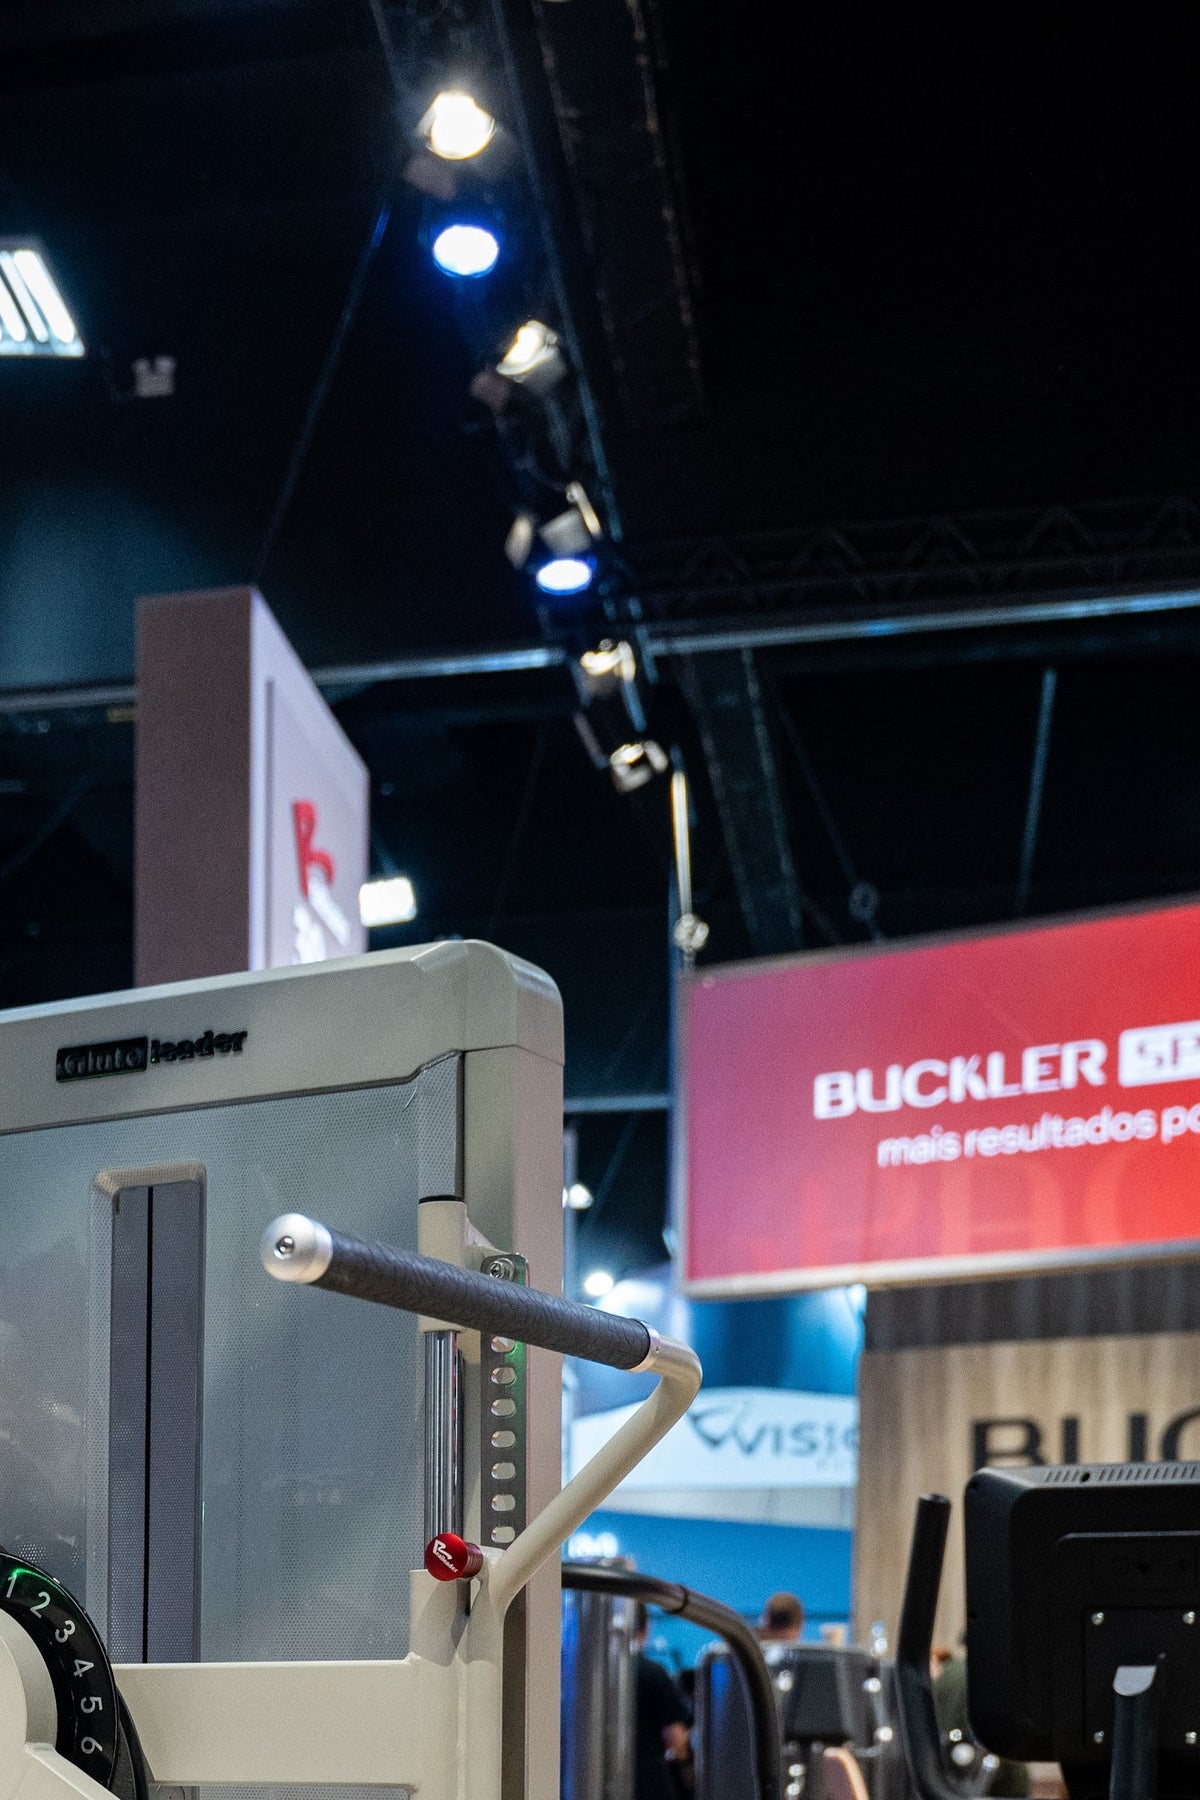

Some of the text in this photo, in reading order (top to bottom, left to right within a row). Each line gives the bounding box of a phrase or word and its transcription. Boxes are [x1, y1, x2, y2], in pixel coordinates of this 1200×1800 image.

[813, 1039, 1107, 1120] BUCKLER
[877, 1125, 962, 1168] mais
[964, 1105, 1158, 1158] resultados
[7, 1575, 18, 1598] 1
[30, 1591, 51, 1618] 2
[55, 1619, 76, 1643] 3
[74, 1659, 95, 1678] 4
[80, 1696, 103, 1714] 5
[80, 1736, 103, 1755] 6
